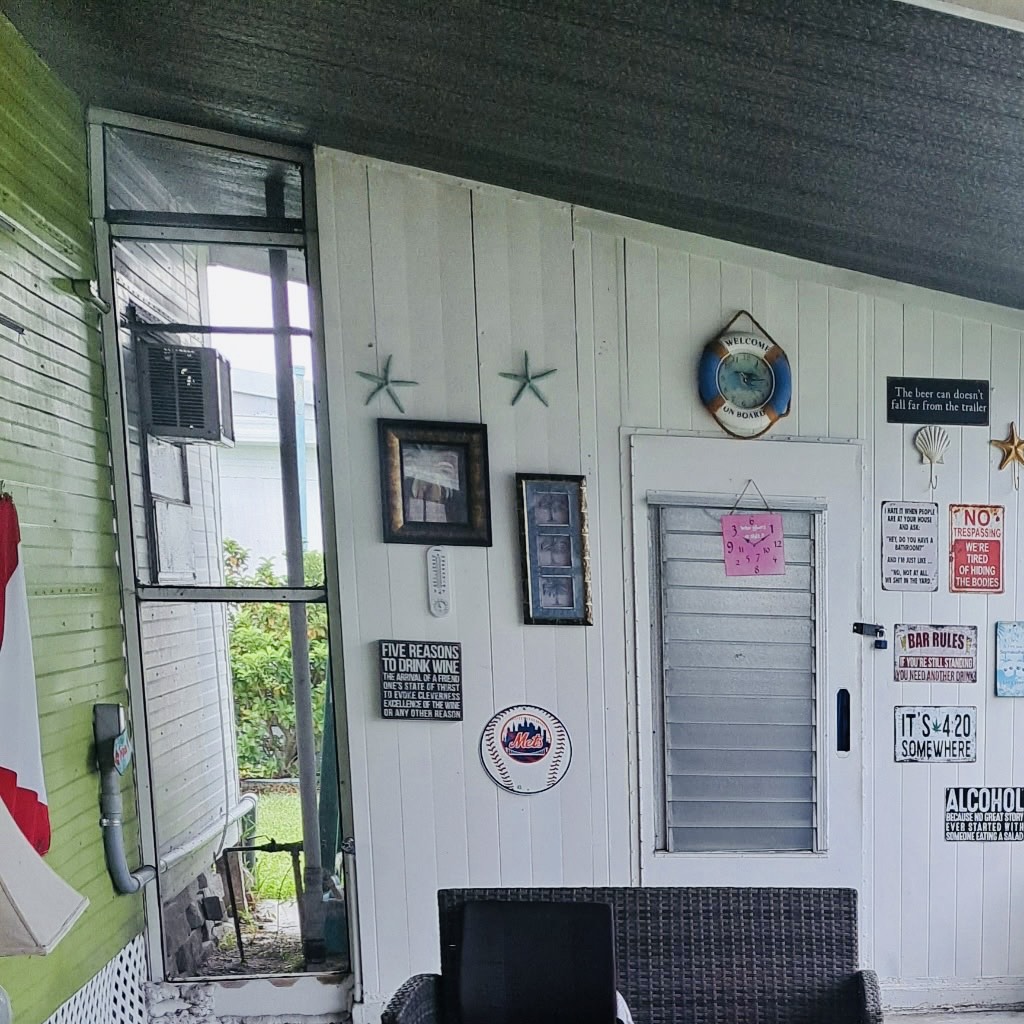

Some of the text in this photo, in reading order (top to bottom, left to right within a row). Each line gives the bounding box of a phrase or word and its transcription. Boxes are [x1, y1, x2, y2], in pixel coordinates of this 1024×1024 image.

[895, 386, 983, 400] The beer can doesn't
[723, 406, 734, 415] ON
[891, 399, 987, 413] fall far from the trailer
[965, 510, 990, 526] NO
[732, 525, 737, 537] 3
[770, 525, 774, 533] 1
[954, 528, 1001, 538] TRESPASSING
[727, 542, 733, 553] 9
[966, 543, 989, 552] WE'RE
[967, 554, 988, 564] TIRED
[755, 565, 759, 574] 8
[960, 565, 995, 575] OF HIDING
[956, 577, 999, 587] THE BODIES
[908, 632, 964, 649] BAR RULES
[382, 643, 459, 659] FIVE REASONS
[382, 658, 459, 674] TO DRINK WINE
[900, 657, 972, 668] IF YOU'RE STILL STANDING
[438, 675, 459, 683] FRIEND
[896, 670, 908, 680] YOU
[909, 670, 925, 681] NEED
[927, 670, 954, 681] ANOTHER
[383, 682, 402, 690] ONE'S
[404, 682, 424, 690] STATE
[437, 683, 460, 691] THIRST
[418, 692, 460, 700] CLEVERNESS
[411, 709, 432, 717] OTHER
[435, 710, 460, 718] REASON
[902, 712, 971, 737] IT'S 4:20
[509, 732, 544, 748] Mets
[902, 740, 971, 758] SOMEWHERE
[946, 788, 1024, 812] ALCOHOL
[946, 812, 1023, 821] BECAUSE NO GREAT STORY
[946, 822, 1024, 831] EVER STARTED WITH
[946, 832, 975, 840] SOMEONE
[976, 832, 997, 840] EATING
[1004, 832, 1023, 841] SALAD
